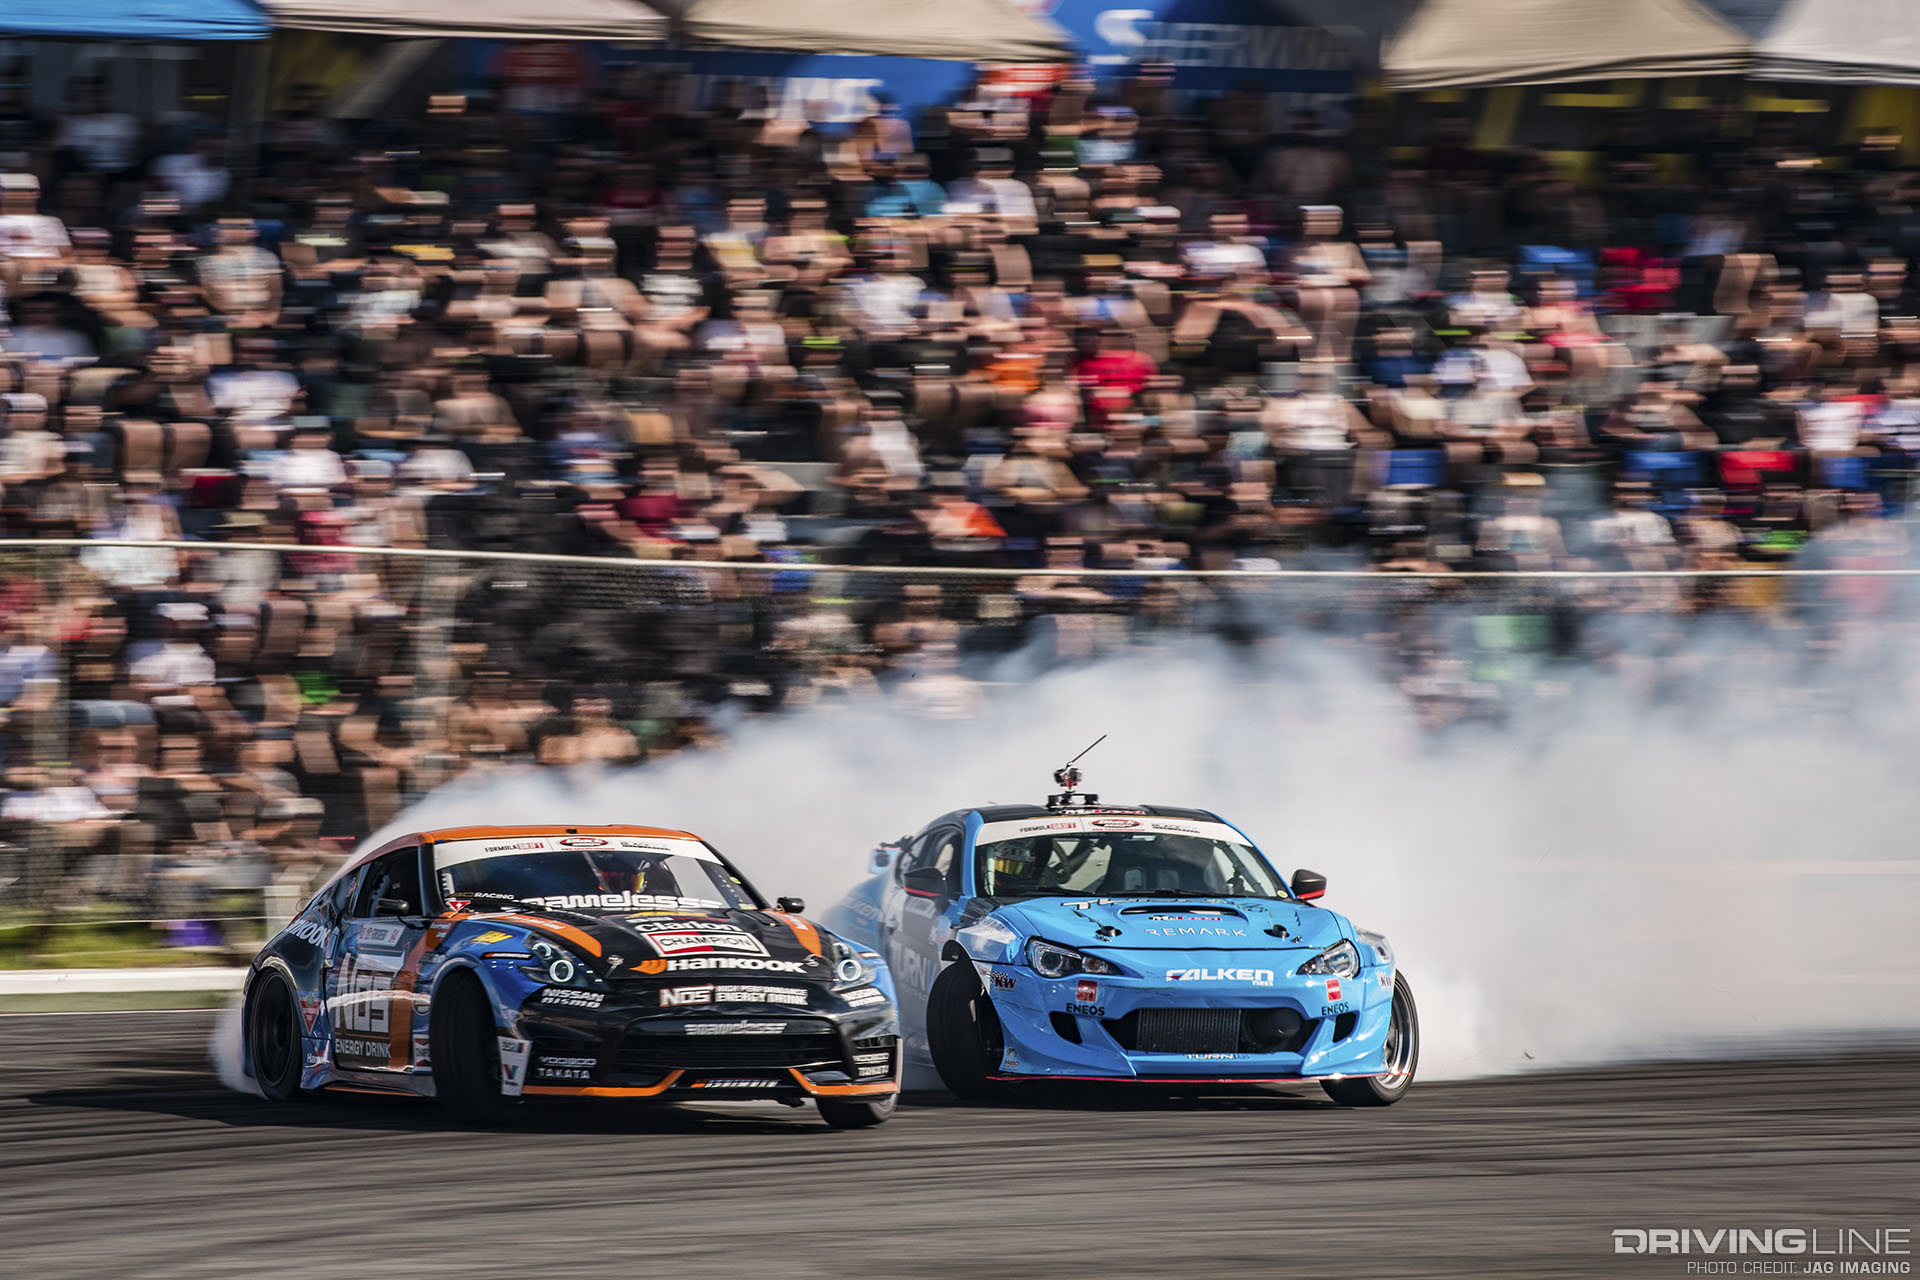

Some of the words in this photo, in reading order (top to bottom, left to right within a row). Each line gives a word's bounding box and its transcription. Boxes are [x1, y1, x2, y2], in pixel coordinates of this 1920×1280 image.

[1020, 825, 1050, 833] FORMULA
[485, 844, 517, 853] FORMULA
[517, 842, 545, 850] DRIFT
[474, 892, 514, 900] RACING
[1143, 927, 1248, 937] REMARK
[660, 934, 751, 947] CHAMPION
[1166, 968, 1274, 981] FALKEN
[1252, 979, 1274, 987] TIRES
[542, 988, 605, 1002] NISSAN
[660, 985, 714, 1006] NOS
[714, 992, 765, 1003] ENERGY
[766, 993, 808, 1005] DRINK
[1066, 1002, 1106, 1016] ENEOS
[1321, 1002, 1350, 1016] ENEOS
[335, 1038, 365, 1055] ENERGY
[365, 1041, 392, 1058] DRINK
[537, 1067, 591, 1080] TAKATA
